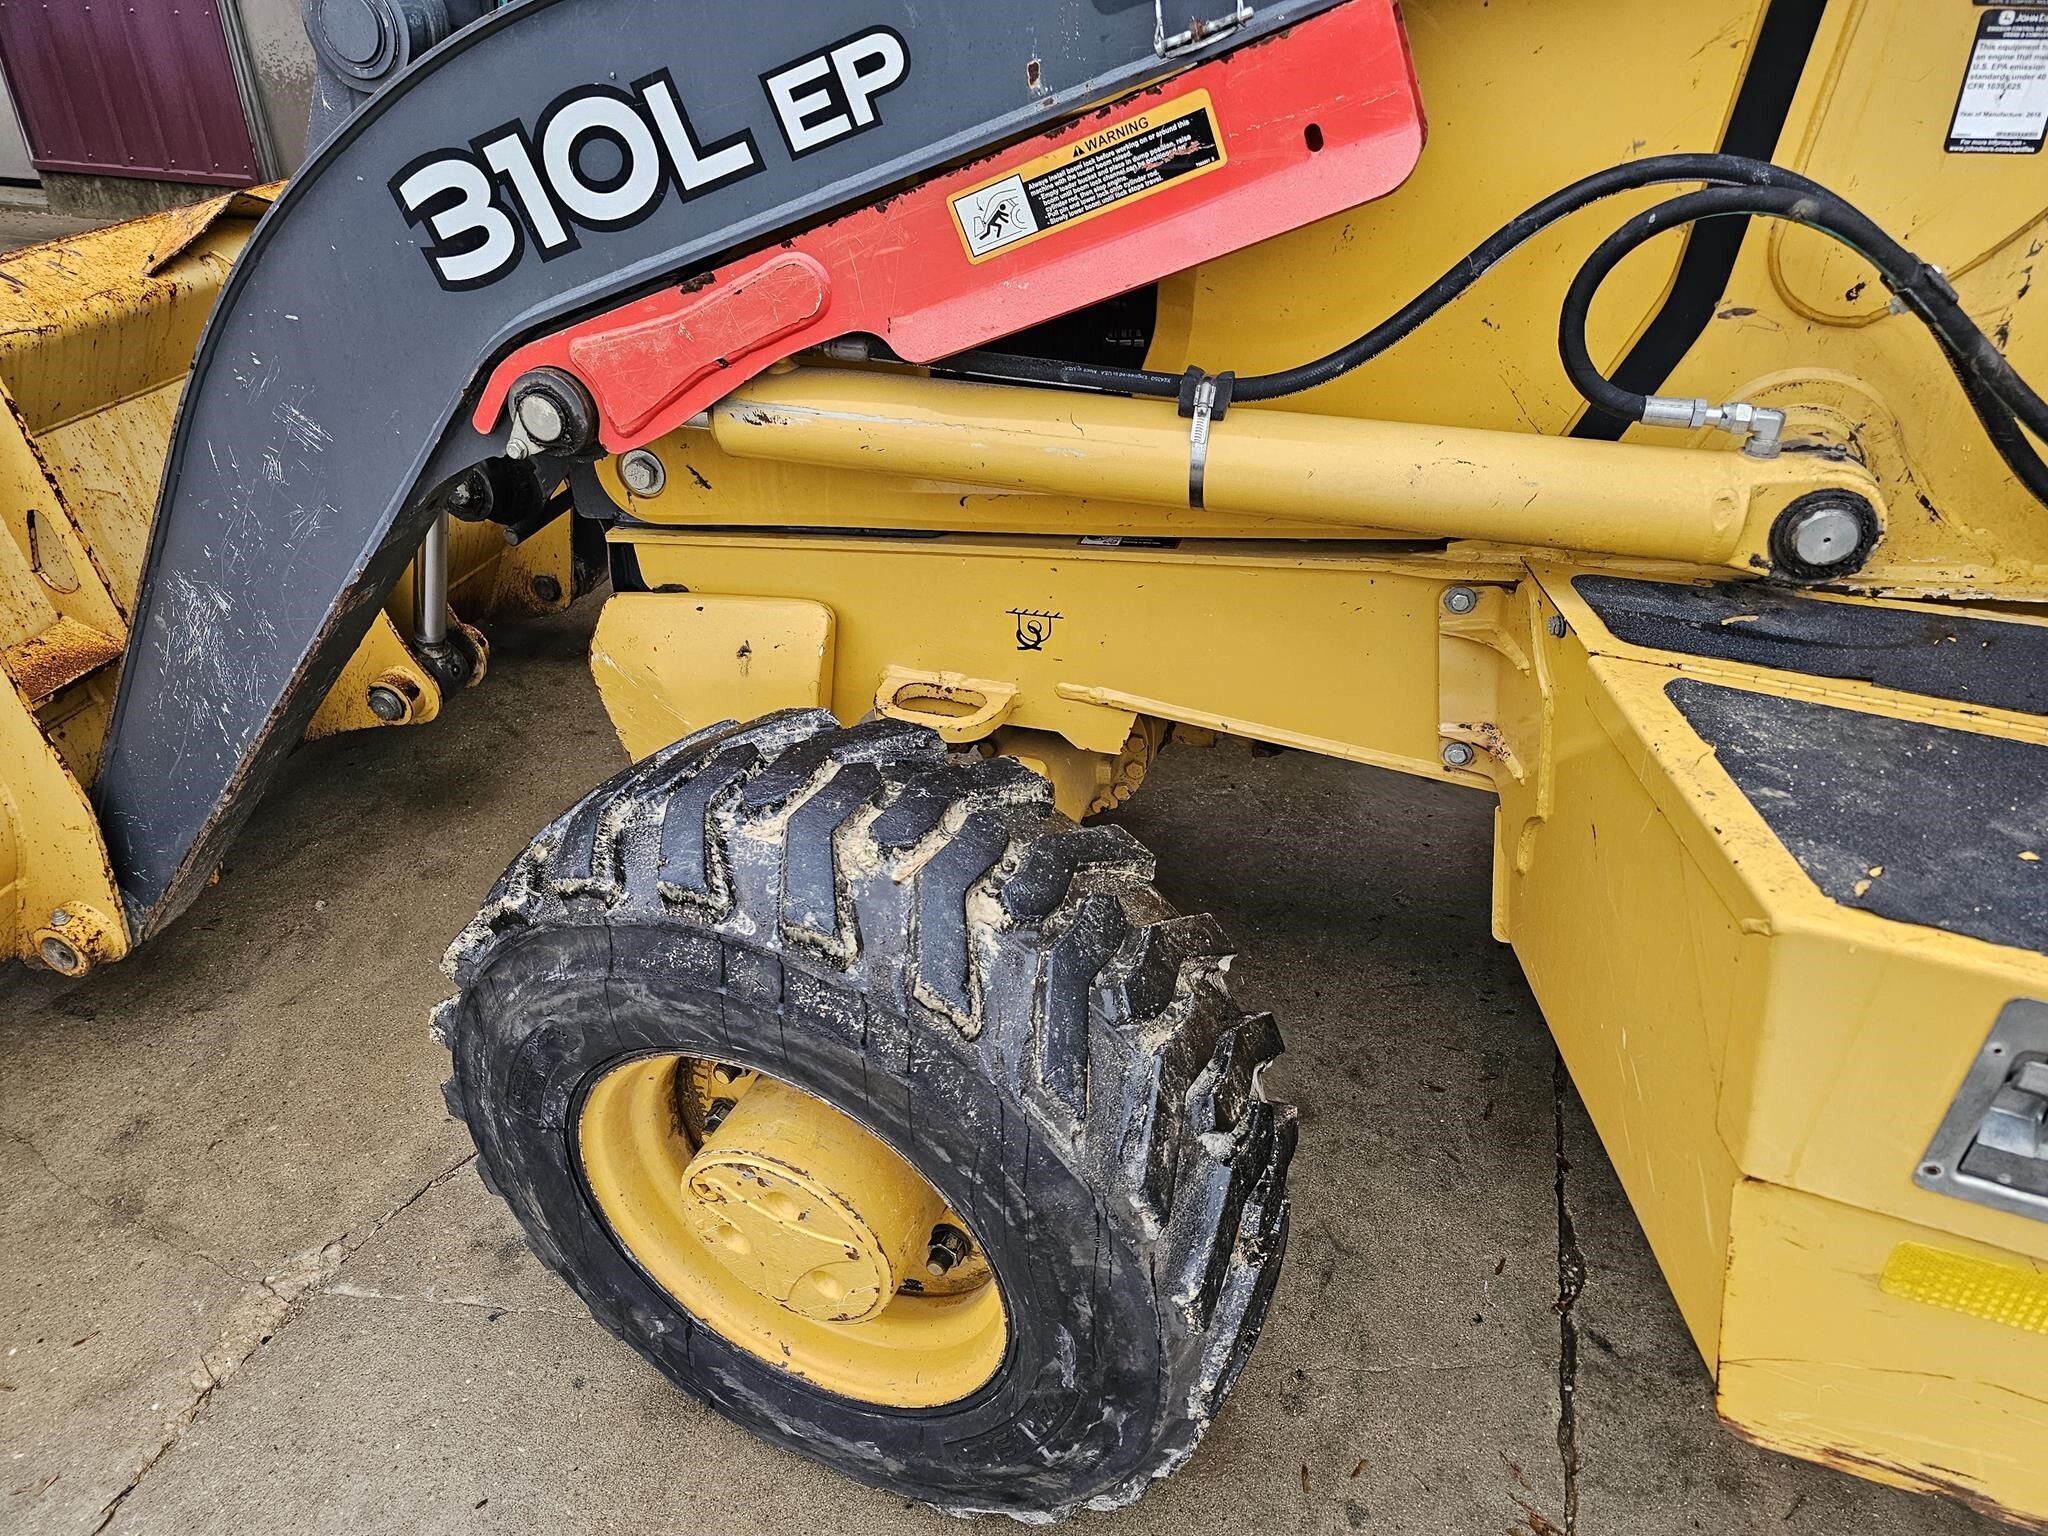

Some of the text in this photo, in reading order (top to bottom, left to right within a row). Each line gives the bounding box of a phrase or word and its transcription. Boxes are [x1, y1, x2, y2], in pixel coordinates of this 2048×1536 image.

[1980, 43, 1996, 51] This
[1998, 44, 2040, 52] equipment
[1966, 82, 1985, 90] CFR
[1969, 73, 2010, 81] standards
[1028, 119, 1190, 191] Always install boom lock before working on or around this
[1084, 117, 1149, 152] WARNING
[397, 30, 906, 284] 310L EP
[1030, 150, 1133, 197] machine with the loader boom raised.
[1059, 181, 1077, 193] loader
[1077, 172, 1098, 185] bucket
[1097, 167, 1109, 177] and
[1109, 162, 1125, 175] place
[1132, 152, 1150, 165] dump
[1176, 133, 1192, 145] raise
[1042, 195, 1060, 206] boom
[1059, 189, 1073, 200] until
[1072, 183, 1090, 194] boom
[1089, 178, 1103, 188] lock
[1102, 169, 1126, 183] channel
[1125, 164, 1138, 173] can
[1045, 199, 1068, 213] cylinder
[1080, 189, 1094, 199] then
[1093, 183, 1107, 195] stop
[1106, 175, 1129, 189] engine.
[1059, 206, 1069, 216] pin
[1068, 201, 1081, 210] and
[1080, 195, 1096, 206] lower
[1095, 189, 1110, 200] lock
[1123, 174, 1147, 190] cylinder
[1147, 169, 1160, 180] rod.
[1068, 207, 1085, 218] lower
[1084, 200, 1102, 212] boom
[1101, 194, 1115, 204] until
[1114, 189, 1128, 200] lock
[1128, 182, 1145, 195] stops
[1144, 175, 1164, 187] travel.
